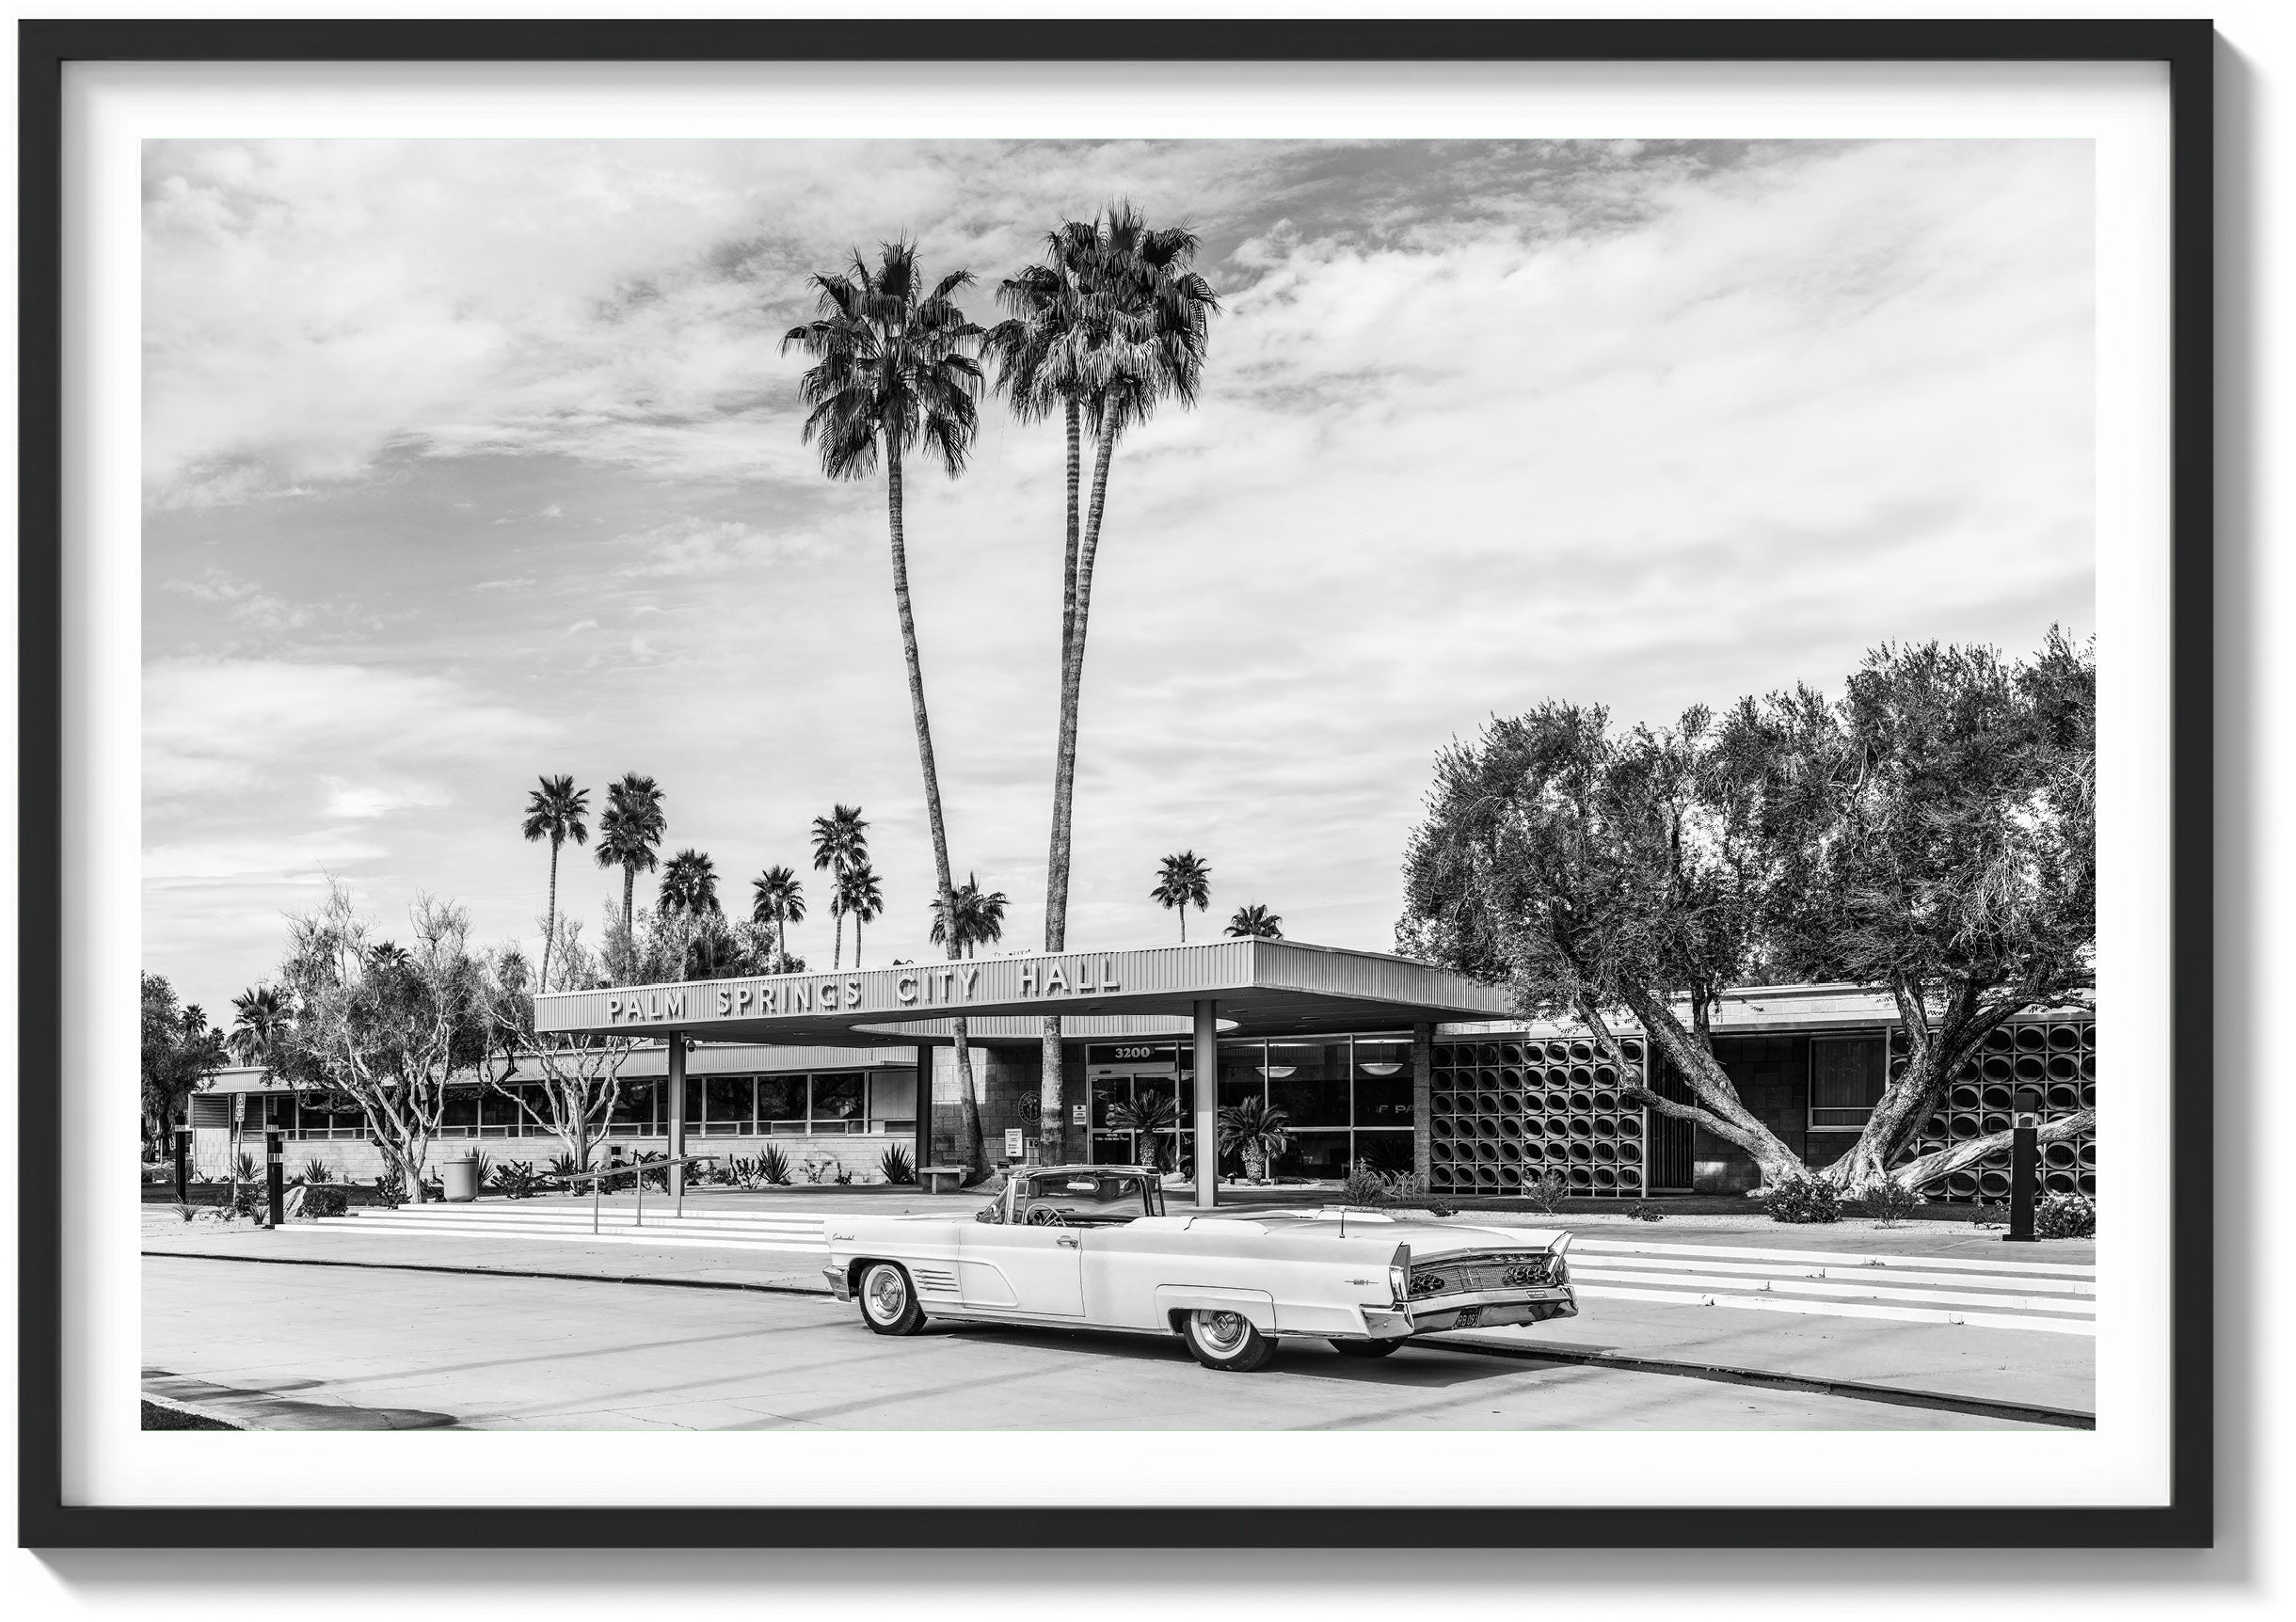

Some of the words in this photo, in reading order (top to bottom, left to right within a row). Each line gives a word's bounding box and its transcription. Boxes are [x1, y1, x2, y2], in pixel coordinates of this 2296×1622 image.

[608, 991, 685, 1021] PALM
[718, 978, 862, 1014] SPRINGS
[896, 968, 978, 1002] CITY
[1019, 958, 1120, 994] HALL
[1115, 1046, 1150, 1058] 3200
